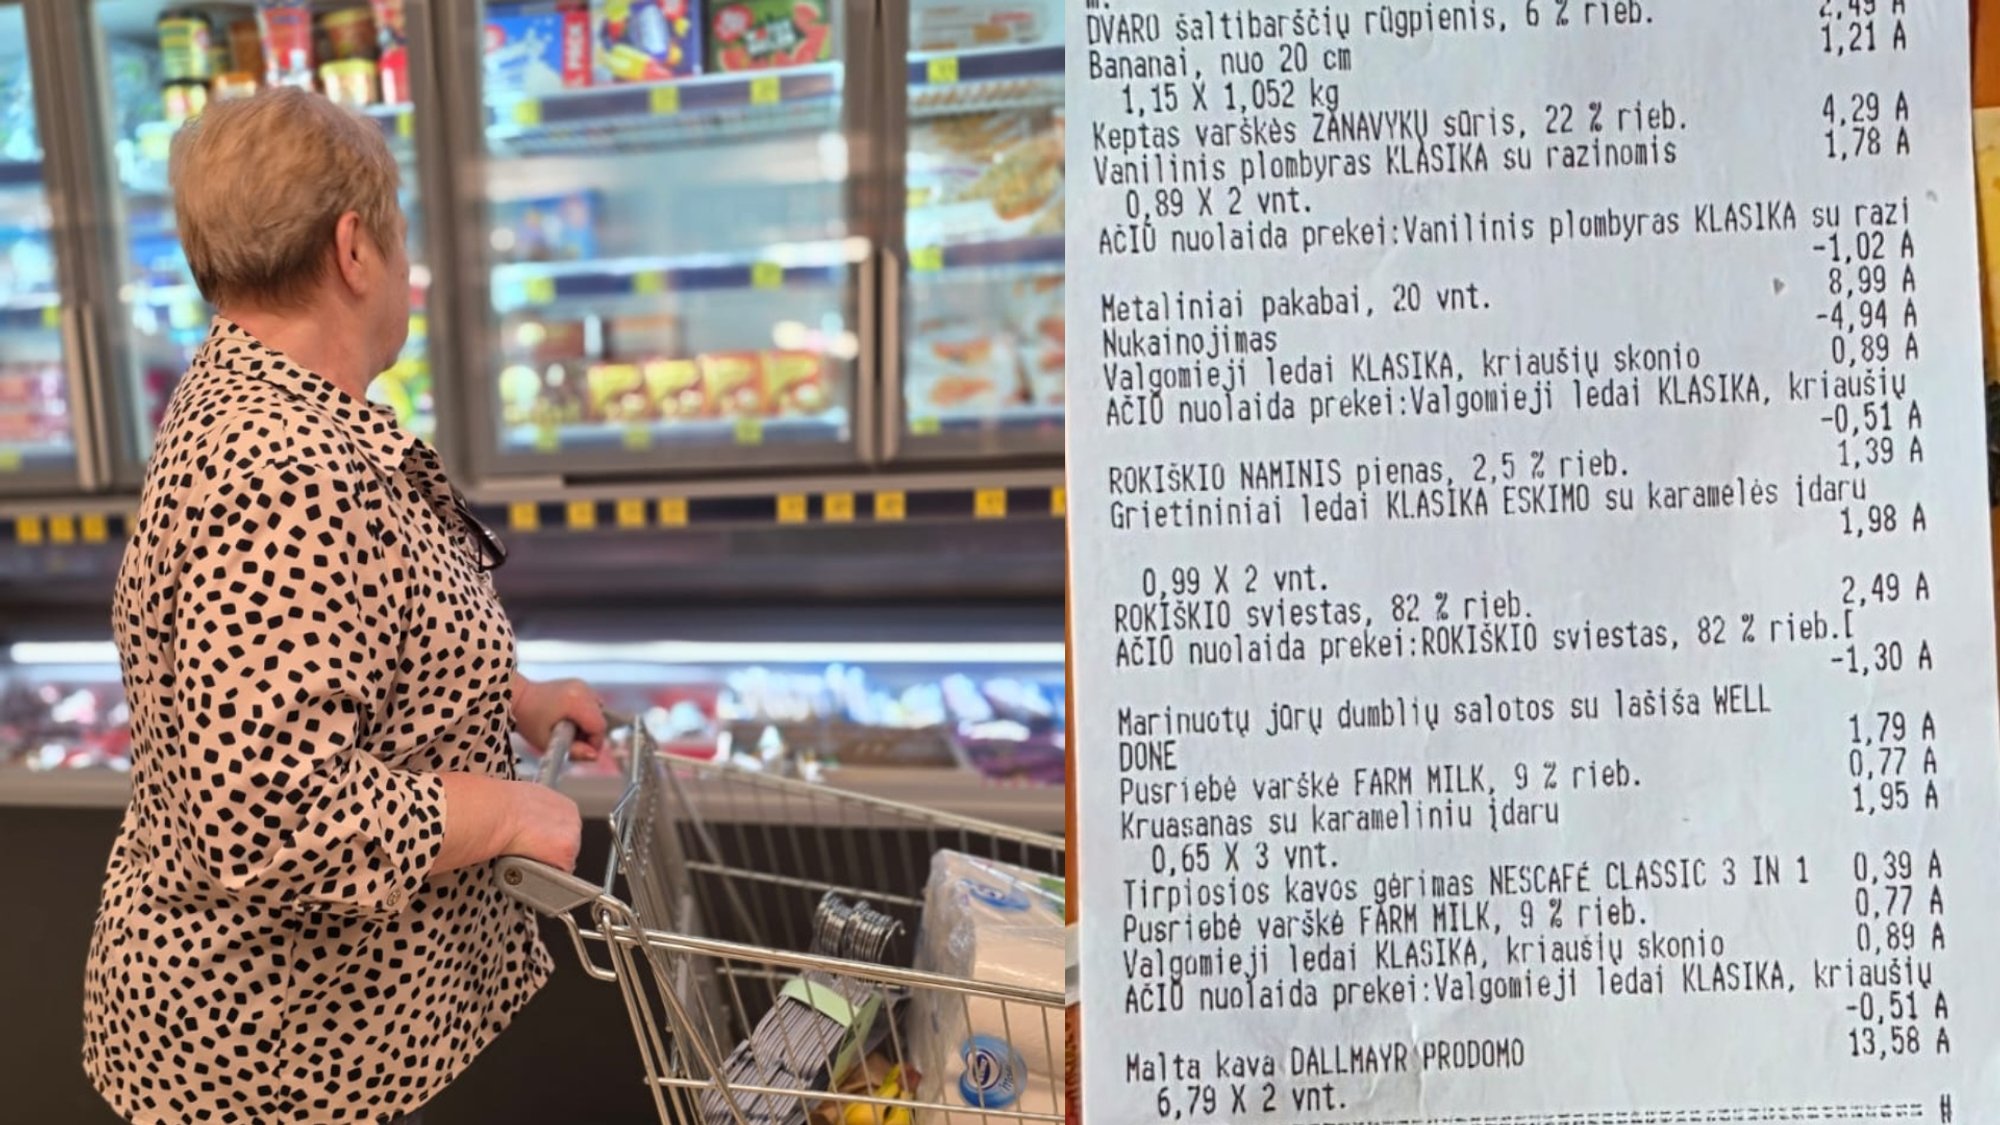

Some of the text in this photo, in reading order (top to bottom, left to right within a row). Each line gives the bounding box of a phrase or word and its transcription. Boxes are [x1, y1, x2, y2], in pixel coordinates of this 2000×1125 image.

[1086, 12, 1160, 46] DVARO
[1175, 6, 1350, 45] šaltibarščių
[1525, 0, 1540, 28] 6
[1584, 0, 1653, 26] rieb.
[1820, 19, 1876, 57] 1,21
[1088, 41, 1352, 84] Bananai, nuo 20 cm
[1121, 76, 1339, 119] 1,15 1,052 kg
[1822, 91, 1880, 130] 4,29
[1092, 120, 1181, 158] Keptas
[1544, 102, 1573, 135] 22
[1617, 99, 1686, 133] rieb.
[1824, 125, 1882, 162] 1,78
[1093, 133, 1677, 190] Vanilinis plombyras KLASIKA su razinomis
[1125, 185, 1311, 224] 0,89 2 vnt.
[1171, 219, 1288, 253] nuolaida
[1549, 207, 1680, 245] plombyras
[1811, 204, 1840, 229] su
[1854, 195, 1909, 228] razi
[1812, 229, 1885, 268] -1,02
[1100, 282, 1490, 324] Metaliniai pakabai, 20 vnt.
[1828, 264, 1887, 302] 8,99
[1816, 298, 1888, 336] -4,94
[1102, 323, 1278, 363] Nukainojimas
[1831, 331, 1890, 370] 0,89
[1102, 341, 1701, 400] Valgomieji ledai KLASIKA, kriaušių skonio
[1178, 388, 1295, 425] nuolaida
[1574, 375, 1640, 410] ledai
[1658, 372, 1771, 406] KLASIKA,
[1788, 368, 1906, 407] kriaušių
[1820, 399, 1893, 439] -0,51
[1239, 458, 1342, 491] NAMINIS
[1356, 456, 1454, 494] pienas,
[1472, 451, 1515, 485] 2,5
[1559, 448, 1628, 479] rieb.
[1837, 435, 1894, 470] 1,39
[1110, 473, 1867, 530] Grietininiai ledai KLASIKA ESKIMO su karamelės įdaru
[1840, 503, 1897, 539] 1,98
[1142, 563, 1328, 603] 0,99 2 vnt.
[1841, 572, 1900, 610] 2,49
[1246, 596, 1372, 631] sviestas,
[1390, 593, 1420, 623] 82
[1463, 588, 1532, 621] rieb.
[1188, 630, 1306, 666] nuolaida
[1553, 619, 1679, 651] sviestas,
[1697, 614, 1726, 646] 82
[1830, 640, 1903, 677] -1,30
[1117, 705, 1250, 739] Marinuotų
[1337, 696, 1439, 732] dumblių
[1453, 692, 1555, 725] salotos
[1570, 696, 1599, 720] su
[1712, 682, 1772, 716] WELL
[1848, 710, 1906, 749] 1,79
[1118, 739, 1178, 773] DONE
[1848, 746, 1907, 783] 0,77
[1119, 757, 1641, 806] Pusriebė varškė FARM MILK, 9 rieb.
[1852, 780, 1909, 817] 1,95
[1120, 796, 1559, 841] Kruasanas su karameliniu įdaru
[1151, 841, 1338, 879] 0,65 3 vnt.
[1853, 849, 1912, 887] 0,39
[1124, 875, 1270, 916] Tirpiosios
[1284, 873, 1358, 905] kavos
[1373, 868, 1474, 909] gėrimas
[1605, 857, 1707, 892] CLASSIC
[1722, 856, 1736, 886] 3
[1753, 854, 1780, 887] IN
[1796, 855, 1809, 884] 1
[1854, 884, 1913, 923] 0,77
[1123, 894, 1646, 944] Pusriebė varškė FARM MILK, 9 rieb.
[1856, 920, 1915, 958] 0,89
[1122, 929, 1725, 986] Valgomieji ledai KLASIKA, kriaušių skonio
[1199, 977, 1318, 1012] nuolaida
[1599, 963, 1663, 996] ledai
[1682, 959, 1795, 994] KLASIKA,
[1814, 955, 1932, 996] kriaušių
[1845, 989, 1919, 1028] -0,51
[1125, 1037, 1525, 1084] Malta kava DALLMAYR PRODOMO
[1848, 1024, 1921, 1061] 13,58
[1156, 1081, 1346, 1121] 6,79 2 vnt.
